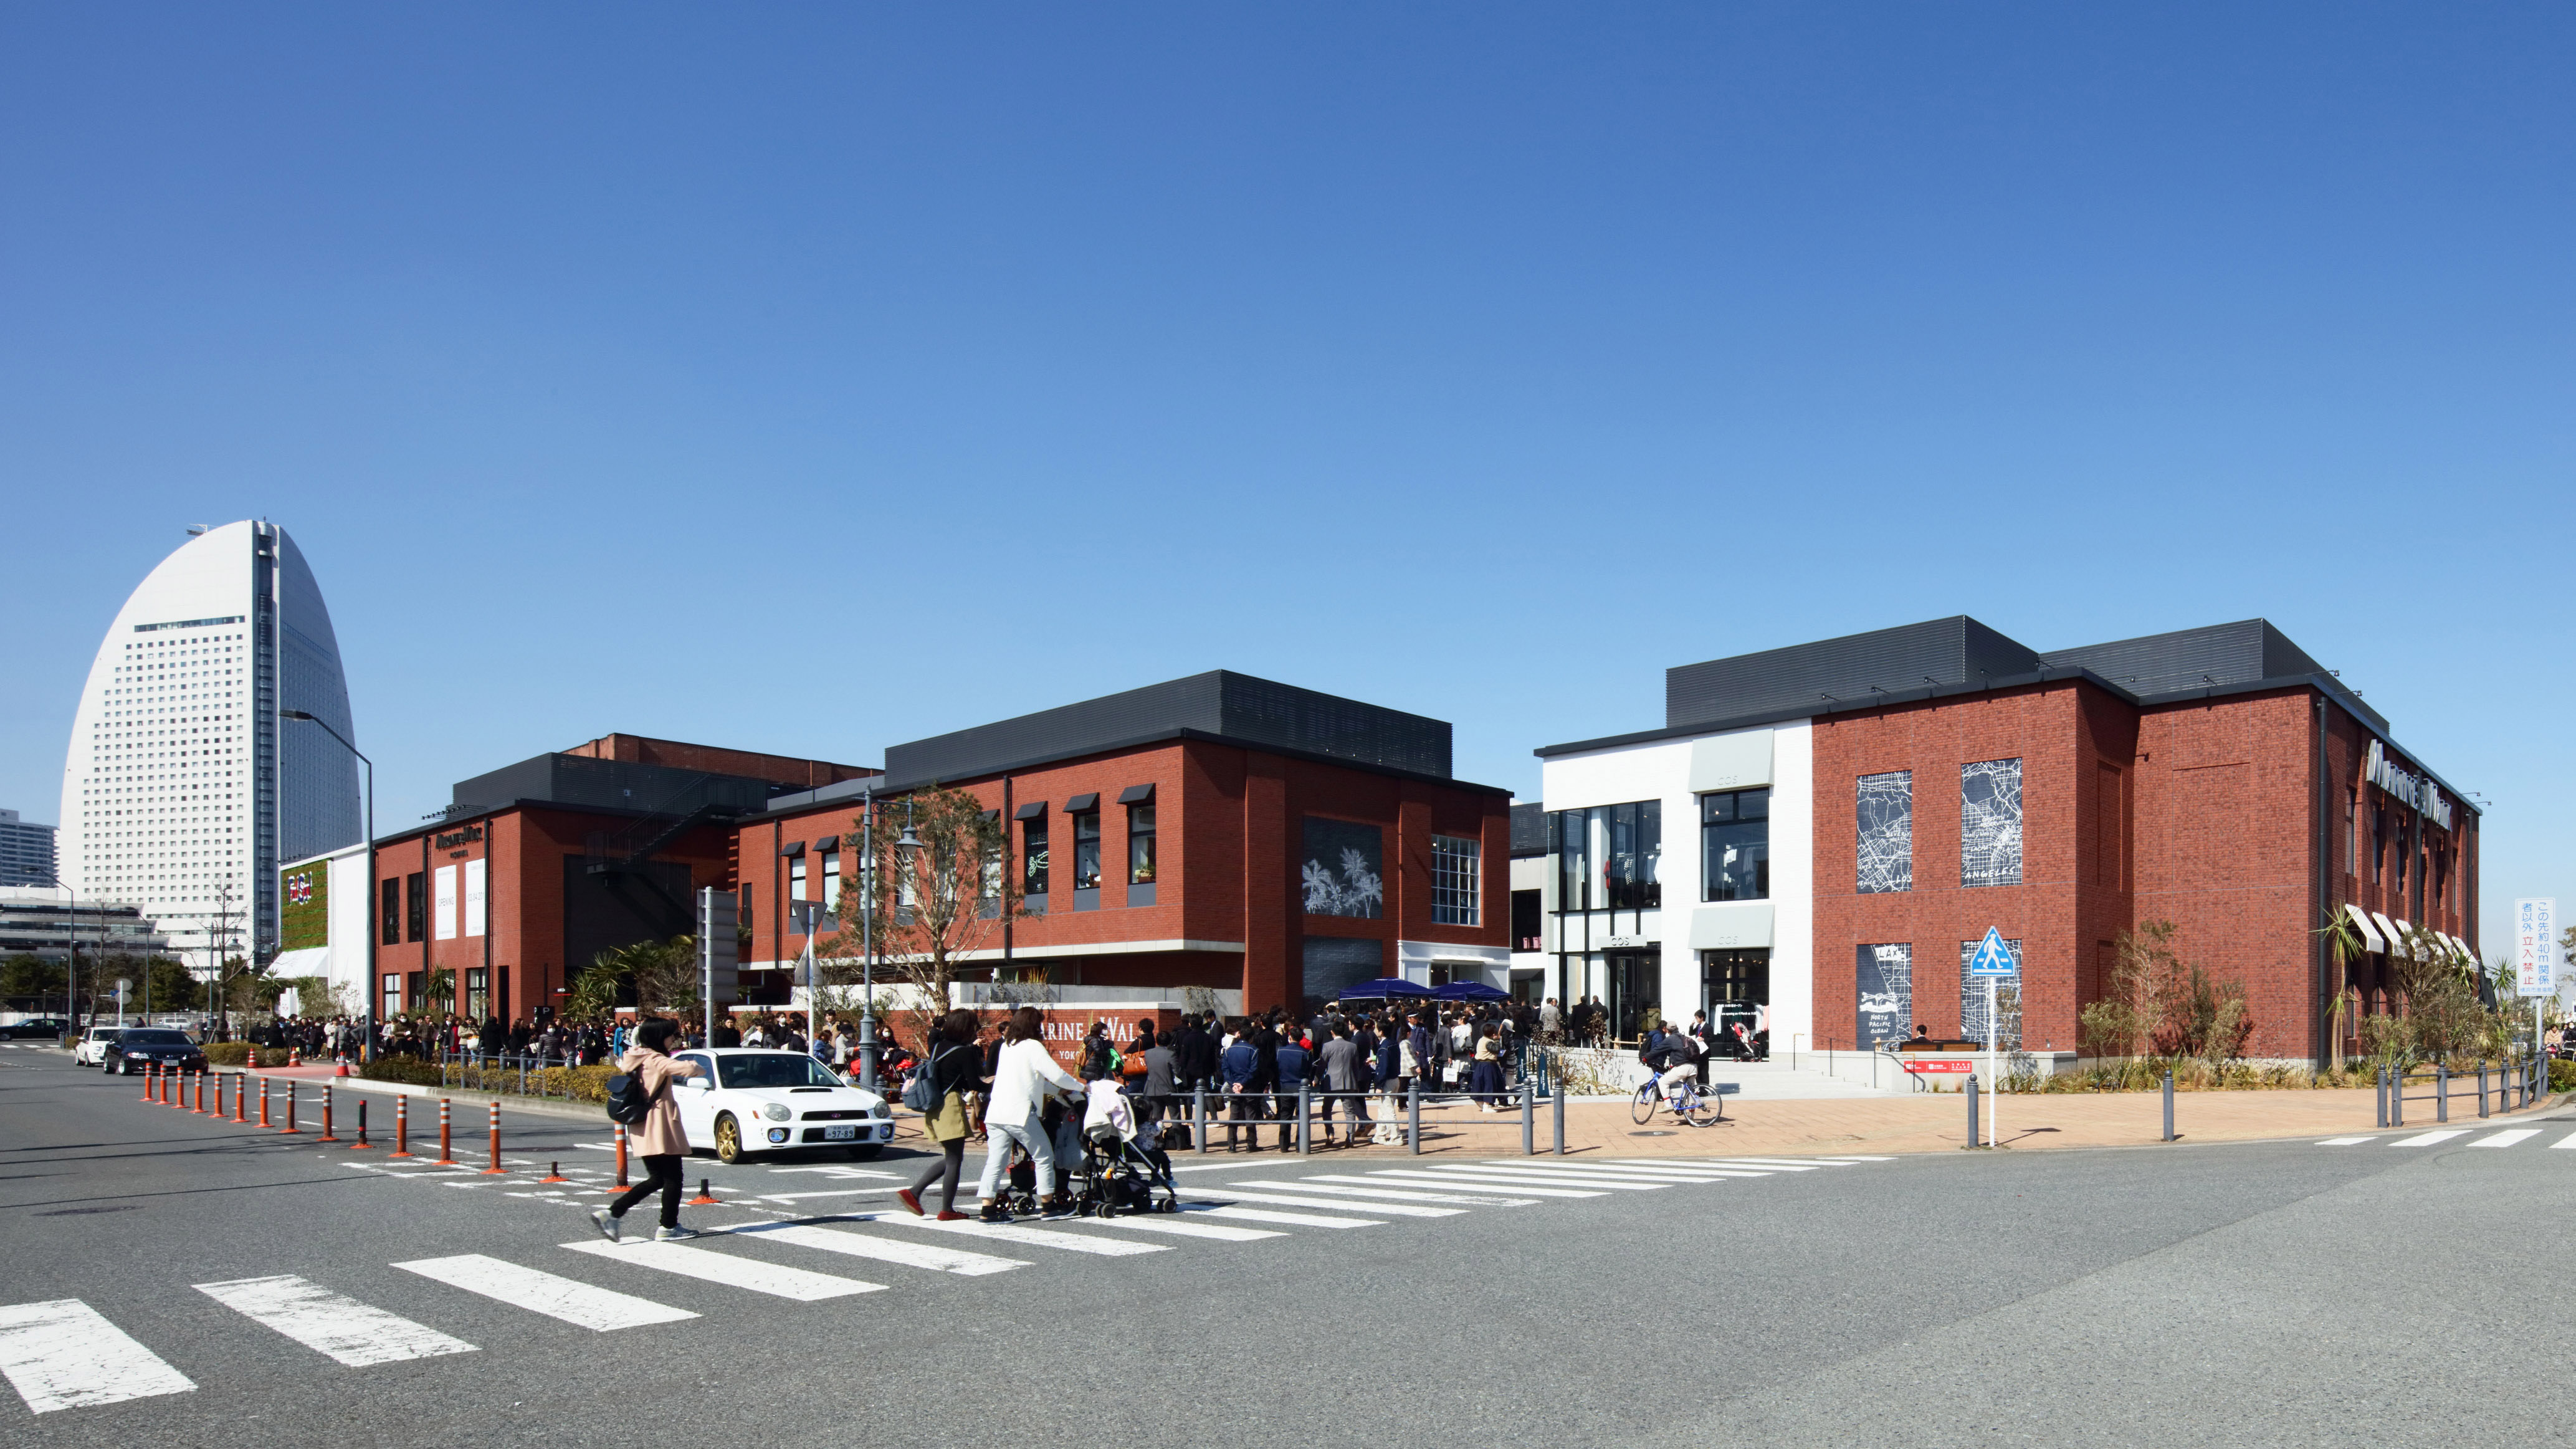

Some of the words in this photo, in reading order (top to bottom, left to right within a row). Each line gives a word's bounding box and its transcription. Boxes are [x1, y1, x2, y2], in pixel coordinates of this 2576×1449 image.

[1718, 775, 1738, 785] COS
[1896, 875, 1912, 883] LOS
[1965, 866, 2015, 879] ANGELES
[1611, 937, 1629, 946] COS
[1718, 936, 1738, 945] COS
[2537, 902, 2550, 985] この先約40m関係
[1879, 949, 1897, 958] LAX
[1040, 1022, 1084, 1041] ARINE
[1100, 1016, 1136, 1041] WAL
